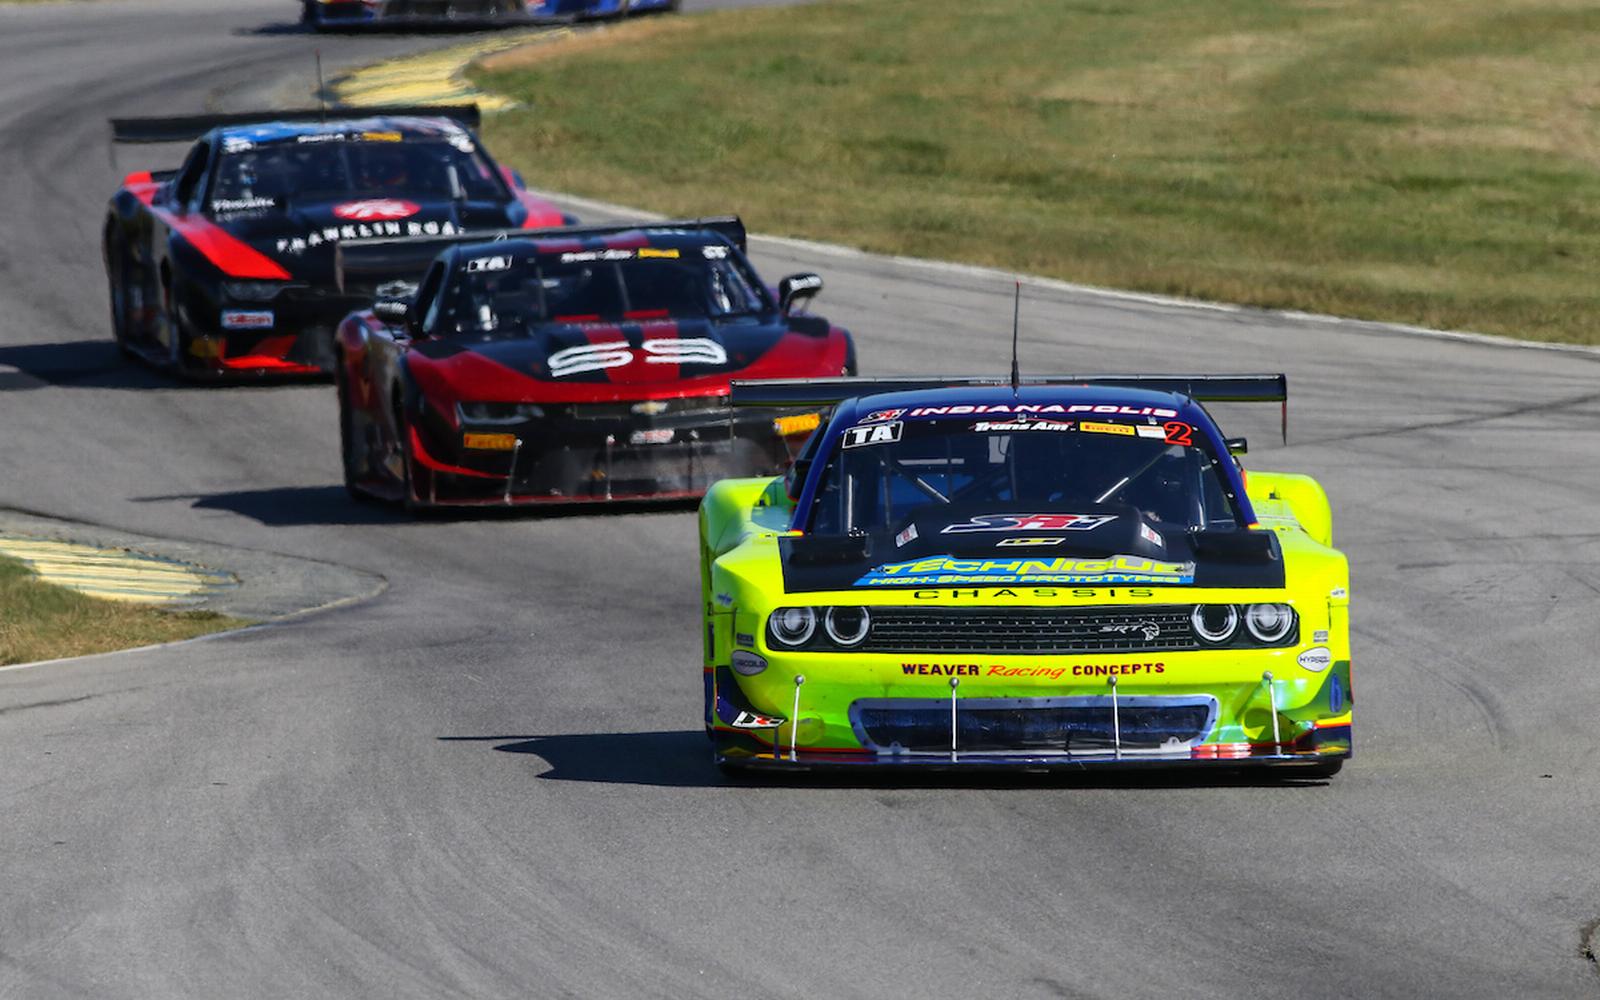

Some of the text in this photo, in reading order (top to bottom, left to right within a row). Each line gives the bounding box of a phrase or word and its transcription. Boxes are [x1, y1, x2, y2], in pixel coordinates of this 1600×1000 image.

[909, 404, 1178, 418] INDIANAPOLIS
[974, 421, 1069, 432] Trans Am
[1163, 421, 1193, 446] 2
[869, 574, 1181, 585] HIGH-SPEED PROTOTYPES
[914, 589, 1154, 599] CHASSIS
[901, 662, 1165, 680] WEAVER Racing CONCEPTS
